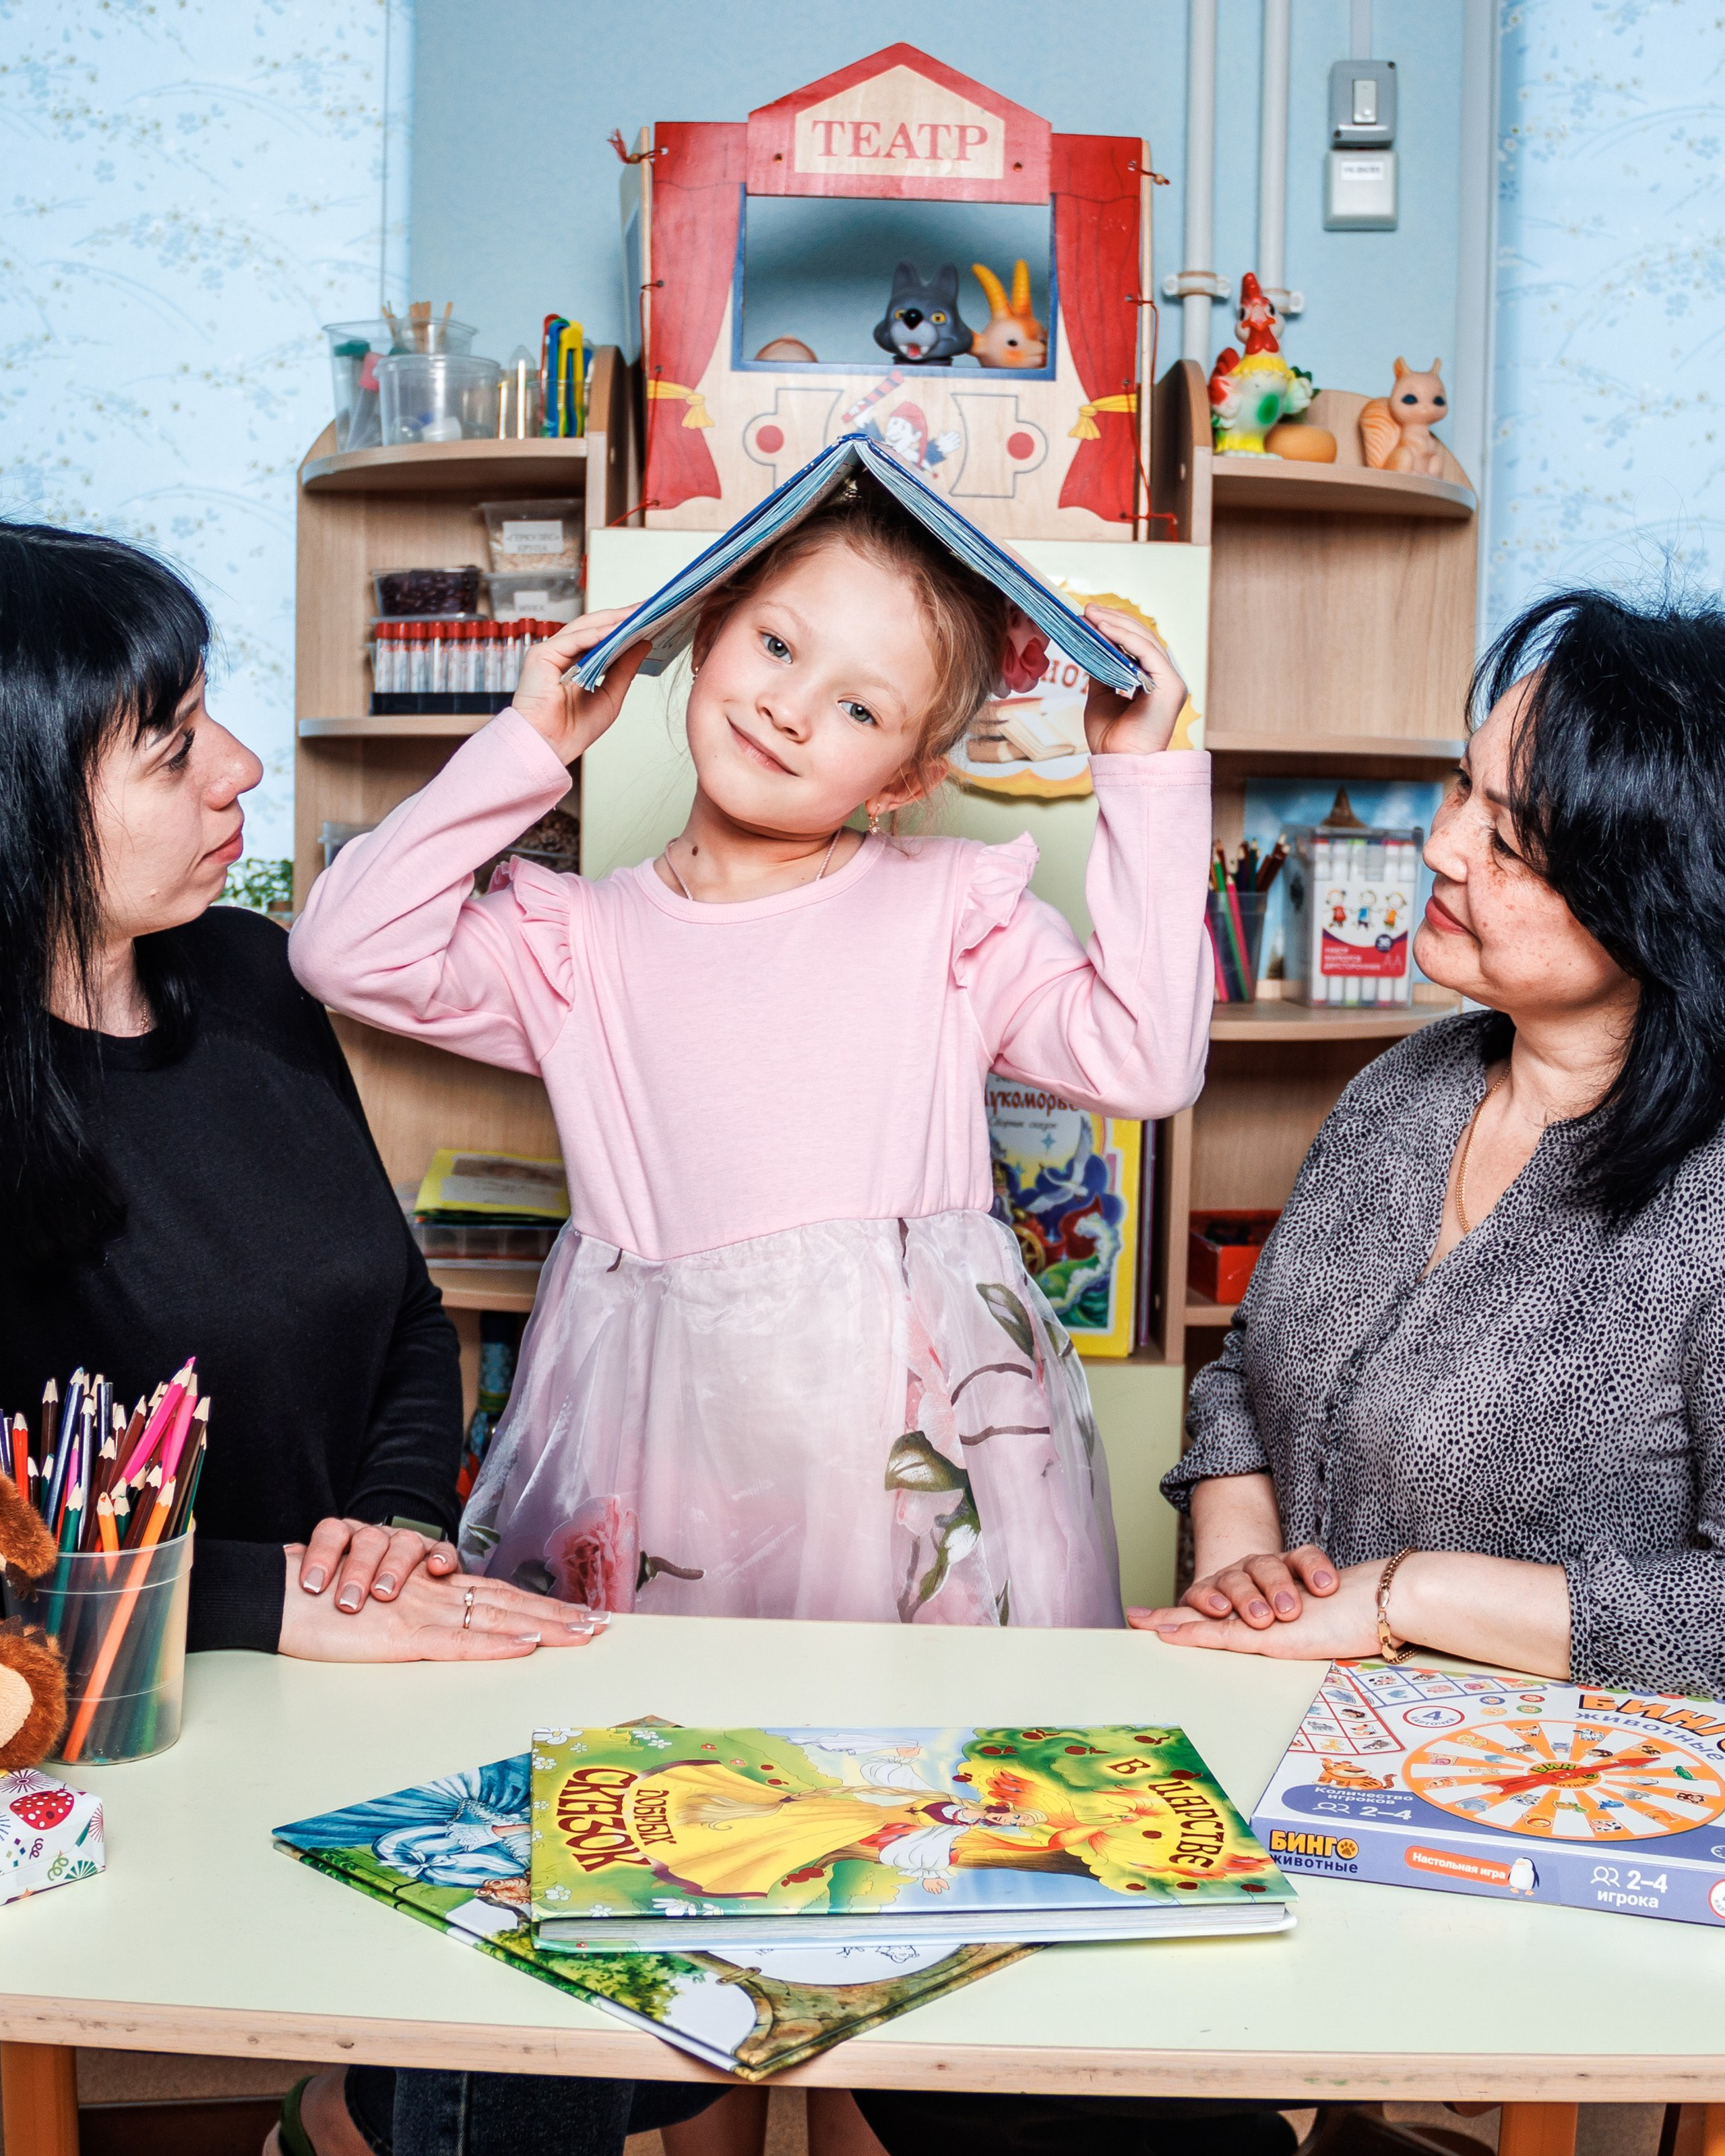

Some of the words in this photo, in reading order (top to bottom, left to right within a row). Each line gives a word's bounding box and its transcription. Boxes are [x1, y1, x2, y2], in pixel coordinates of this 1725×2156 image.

[812, 120, 988, 162] ТЕАТР
[984, 1083, 1079, 1116] укоморь
[1422, 1711, 1442, 1720] 4
[1315, 1787, 1414, 1801] Количество
[1327, 1794, 1395, 1805] игроков
[557, 1768, 651, 1872] СКАЗОК
[633, 1789, 678, 1845] ДОБРЫХ
[1106, 1758, 1151, 1774] В
[1148, 1780, 1225, 1869] ЦАРСТВЕ
[1412, 1851, 1478, 1874] Настольная
[1480, 1866, 1507, 1880] игра
[1597, 1890, 1660, 1909] игрока
